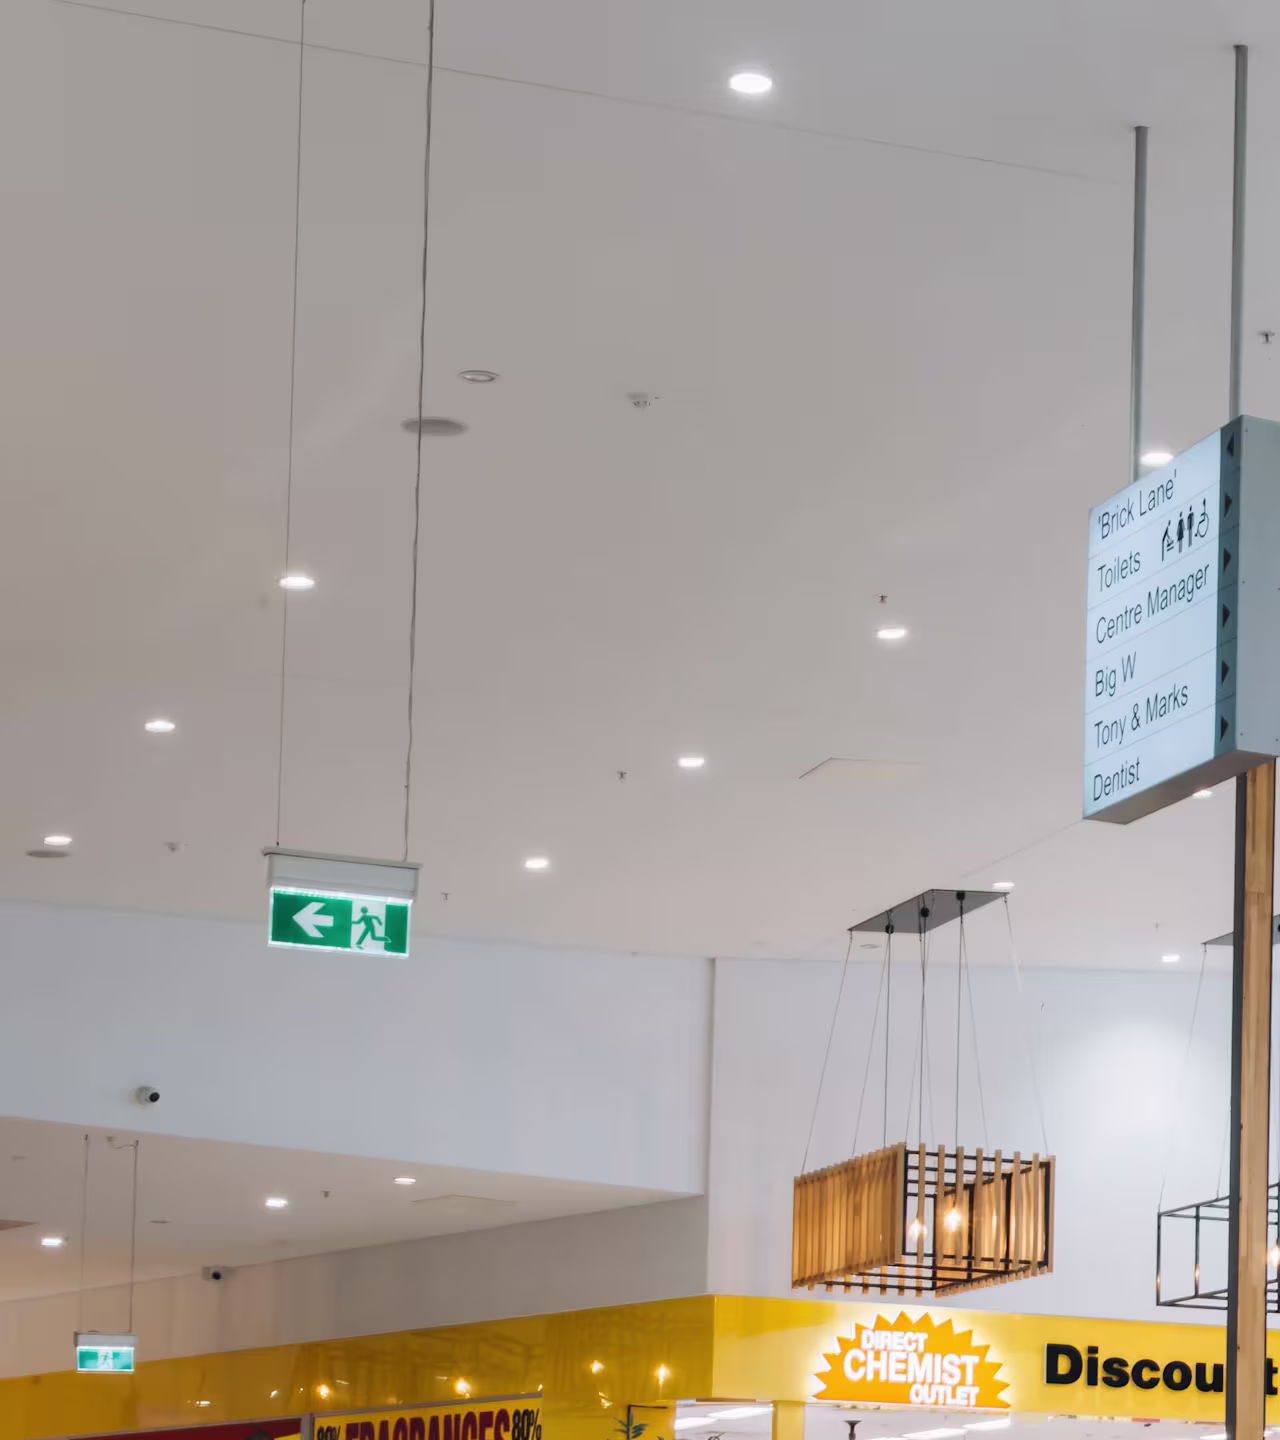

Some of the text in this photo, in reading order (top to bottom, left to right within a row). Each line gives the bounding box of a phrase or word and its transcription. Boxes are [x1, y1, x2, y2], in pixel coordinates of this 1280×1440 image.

[1098, 468, 1177, 541] 'Brick Lane'
[1097, 548, 1141, 593] Toilets
[1096, 562, 1210, 644] Centre Manager
[1095, 651, 1137, 699] Big W
[1094, 683, 1188, 749] Tony & Marks
[1093, 757, 1140, 802] Dentist
[861, 1329, 928, 1352] DIRECT
[843, 1348, 980, 1386] CHEMIST
[1044, 1342, 1279, 1395] Discout
[909, 1383, 980, 1406] OUTLET
